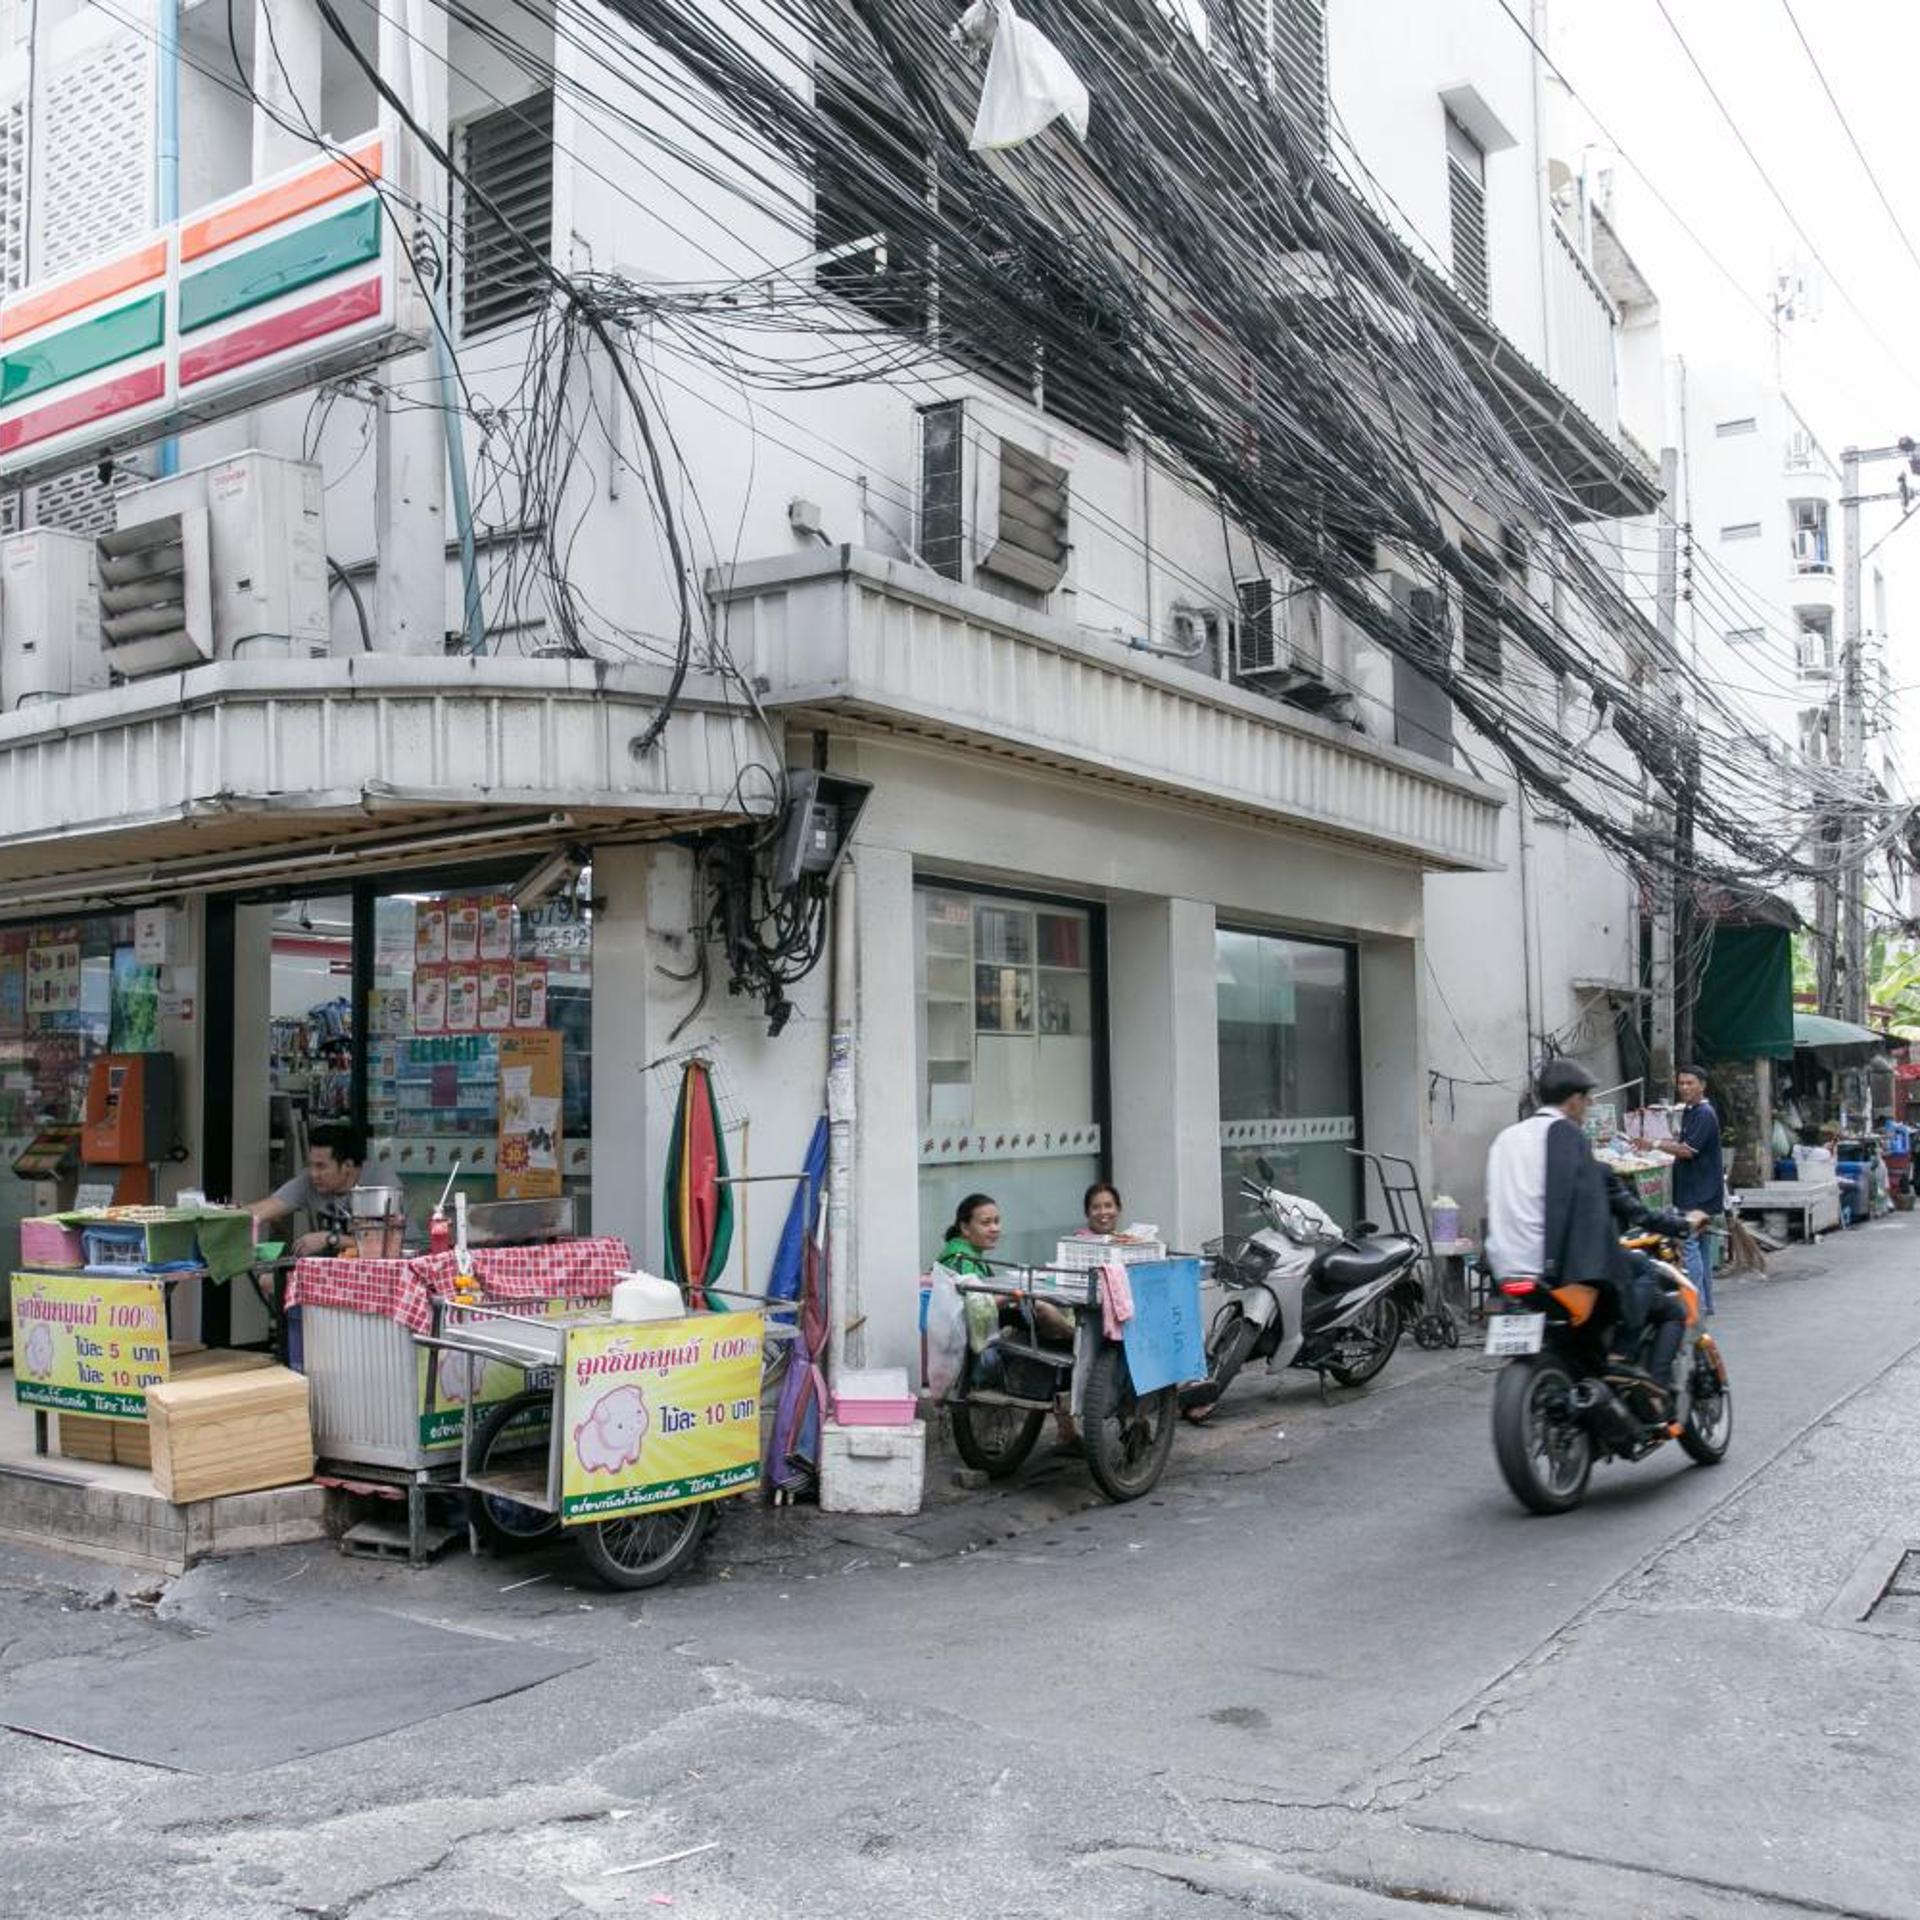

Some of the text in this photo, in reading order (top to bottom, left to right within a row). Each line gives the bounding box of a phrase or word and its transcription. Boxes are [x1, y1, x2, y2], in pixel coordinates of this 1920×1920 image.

[108, 1305, 158, 1329] 100%
[110, 1340, 120, 1359] 5
[133, 1346, 160, 1363] บาท
[577, 1337, 759, 1387] ลูกชิ้นหมูแท้ 100%
[112, 1371, 129, 1387] 10
[659, 1399, 754, 1434] ไม้ละ 10 บาท
